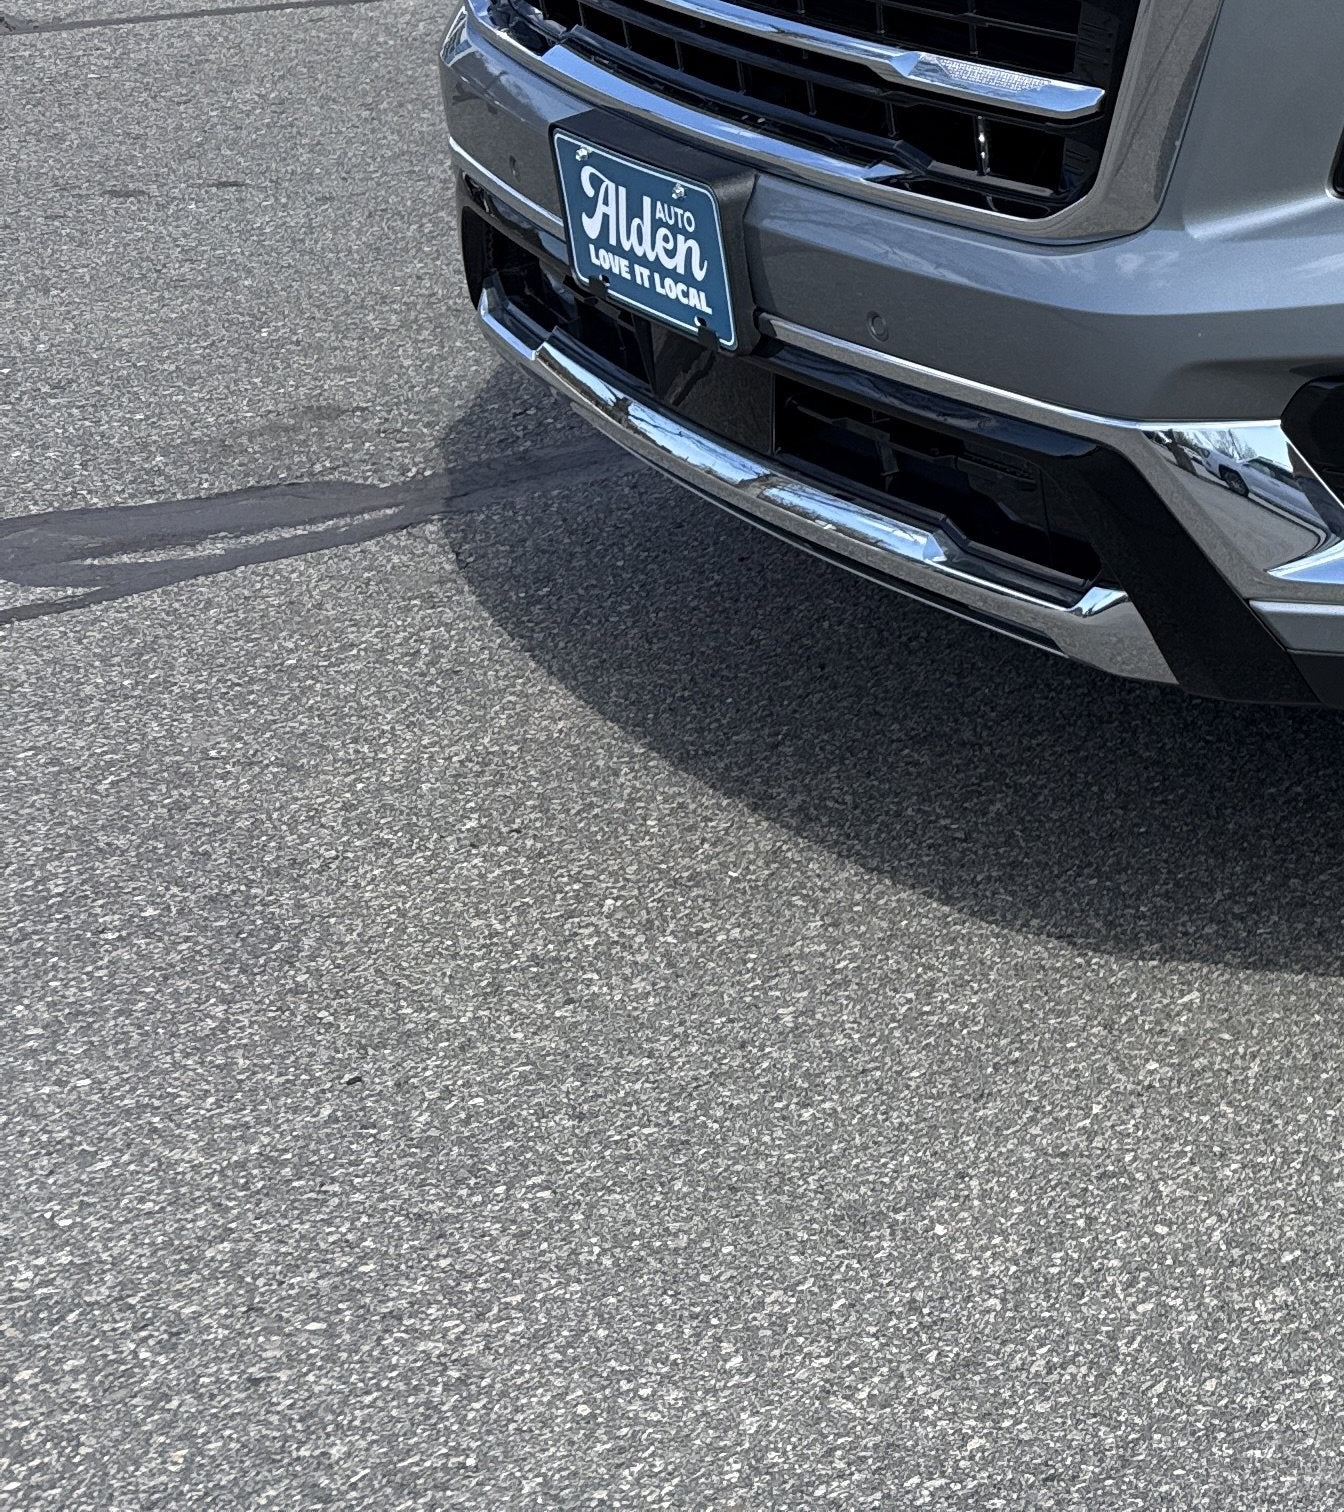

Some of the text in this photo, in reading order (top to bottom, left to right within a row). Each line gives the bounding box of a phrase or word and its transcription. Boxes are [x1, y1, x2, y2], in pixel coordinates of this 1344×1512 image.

[580, 165, 708, 282] Alden
[655, 200, 696, 233] AUTO
[588, 243, 713, 316] LOVE IT LOCAL
